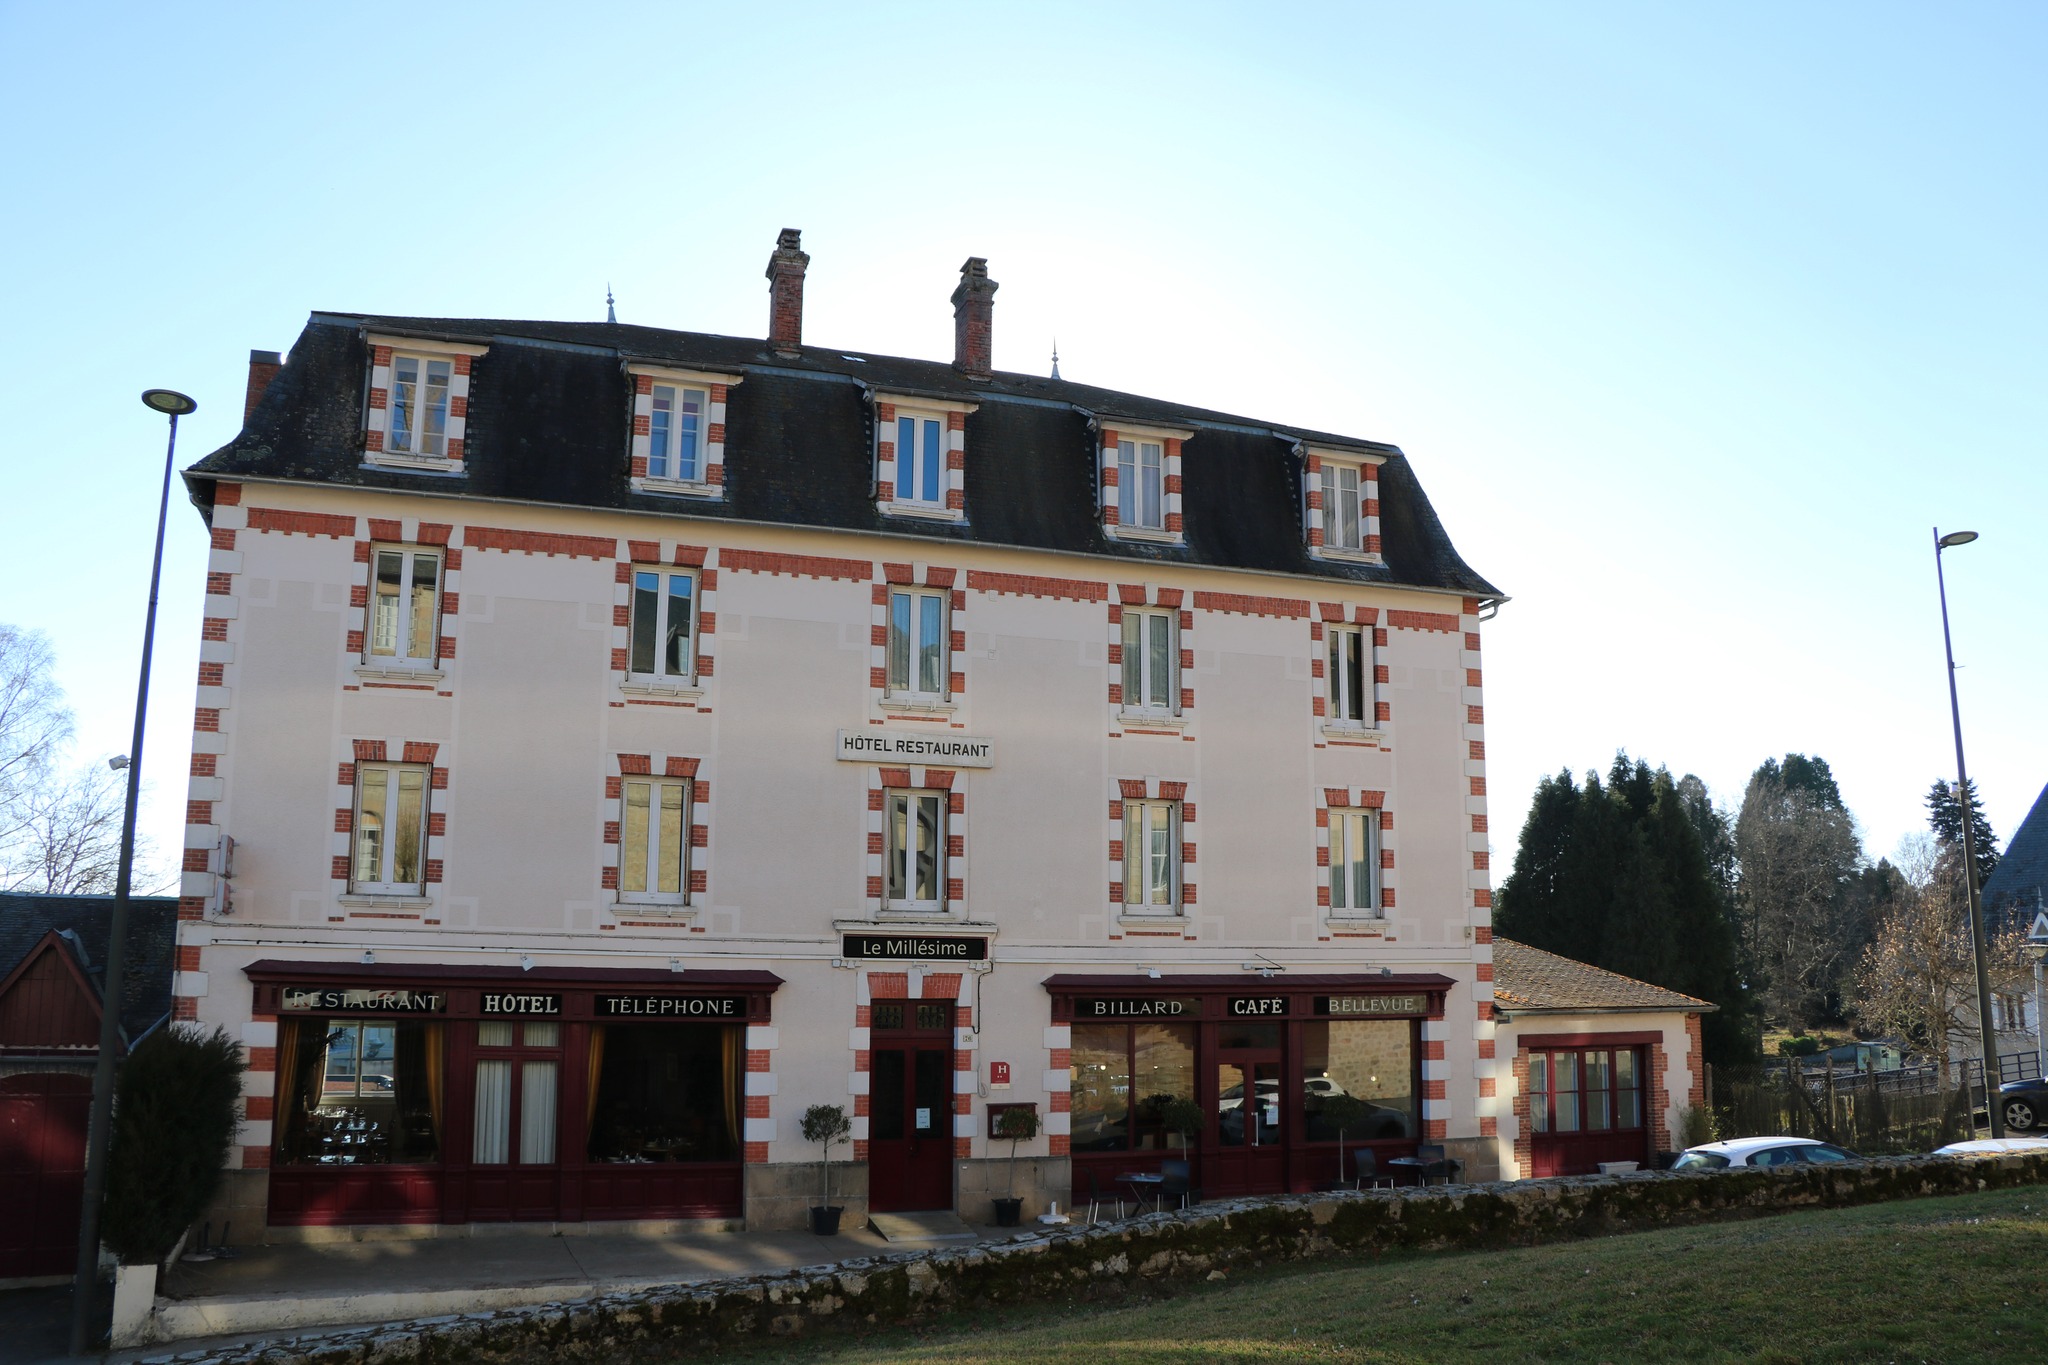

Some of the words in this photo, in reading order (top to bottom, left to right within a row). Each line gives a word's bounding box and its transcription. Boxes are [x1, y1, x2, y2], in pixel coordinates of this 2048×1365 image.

[844, 735, 892, 752] HÔTEL
[896, 740, 989, 757] RESTAURANT
[863, 940, 881, 955] Le
[886, 939, 967, 955] Millésime
[293, 991, 440, 1010] RESTAURANT
[484, 994, 558, 1013] HÔTEL
[607, 996, 734, 1014] TÉLÉPHONE
[1094, 1001, 1183, 1015] BILLARD
[1234, 997, 1283, 1014] CAFÉ
[1329, 998, 1414, 1012] BELLEVUE
[998, 1065, 1007, 1074] H
